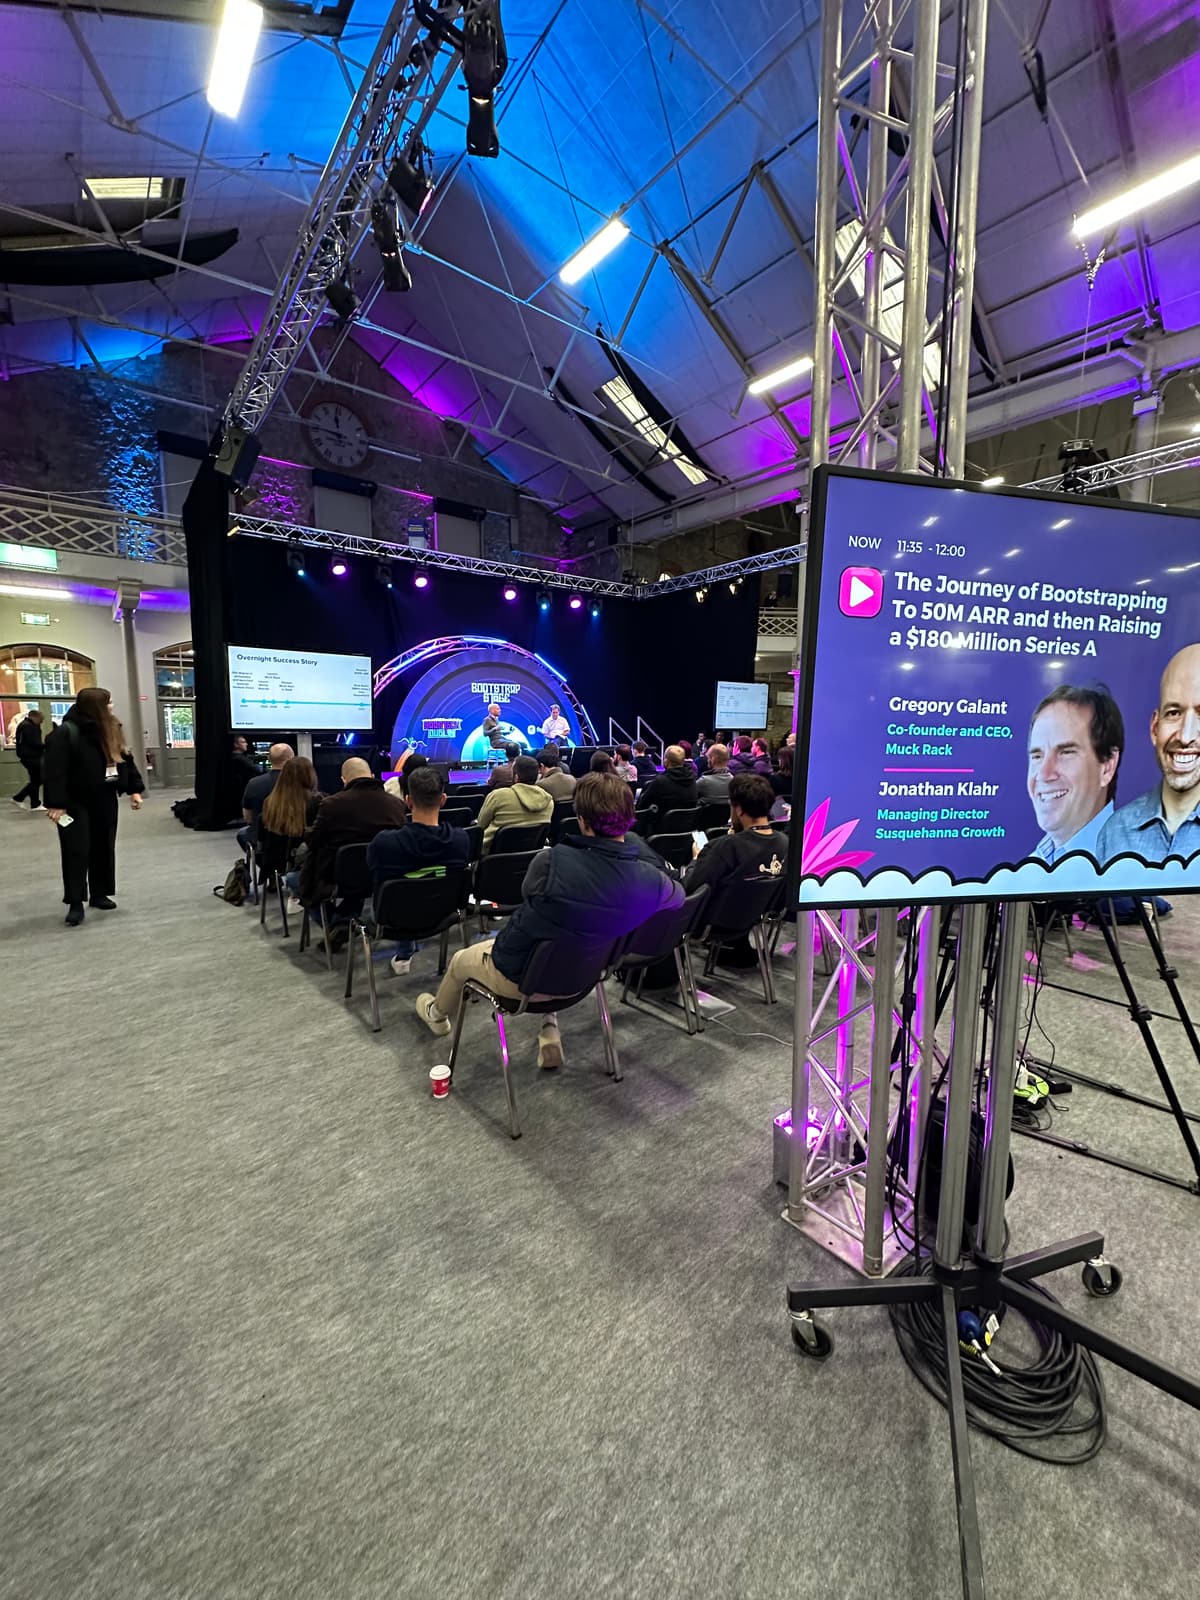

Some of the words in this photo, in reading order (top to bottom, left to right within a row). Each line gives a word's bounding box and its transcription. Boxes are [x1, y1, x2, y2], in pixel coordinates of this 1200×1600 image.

[848, 535, 882, 550] NOW
[897, 540, 923, 553] 11:35
[935, 543, 966, 557] 12:00
[894, 571, 933, 592] The
[935, 575, 1016, 603] Journey
[1018, 582, 1040, 600] of
[1041, 583, 1168, 614] Bootstrapping
[892, 599, 918, 619] To
[920, 601, 964, 622] 50M
[966, 605, 1010, 626] ARR
[1013, 610, 1049, 628] and
[1053, 611, 1095, 631] then
[1098, 614, 1162, 639] Raising
[889, 630, 902, 646] a
[905, 625, 953, 650] $180
[957, 631, 1022, 653] Million
[1024, 636, 1081, 655] Series
[1082, 639, 1098, 657] A
[236, 653, 272, 663] Overnight
[272, 656, 300, 665] Success
[300, 658, 318, 666] Story
[471, 682, 521, 695] BOOTSTRAP
[889, 697, 953, 716] Gregory
[956, 699, 1008, 715] Galant
[887, 723, 958, 737] Co-founder
[959, 725, 983, 738] and
[984, 726, 1014, 739] CEO,
[885, 743, 920, 755] Muck
[922, 743, 953, 756] Rack
[878, 781, 954, 797] Jonathan
[957, 781, 999, 797] Klahr
[877, 808, 938, 822] Managing
[940, 807, 990, 820] Director
[875, 827, 960, 841] Susquehanna
[961, 826, 1006, 838] Growth
